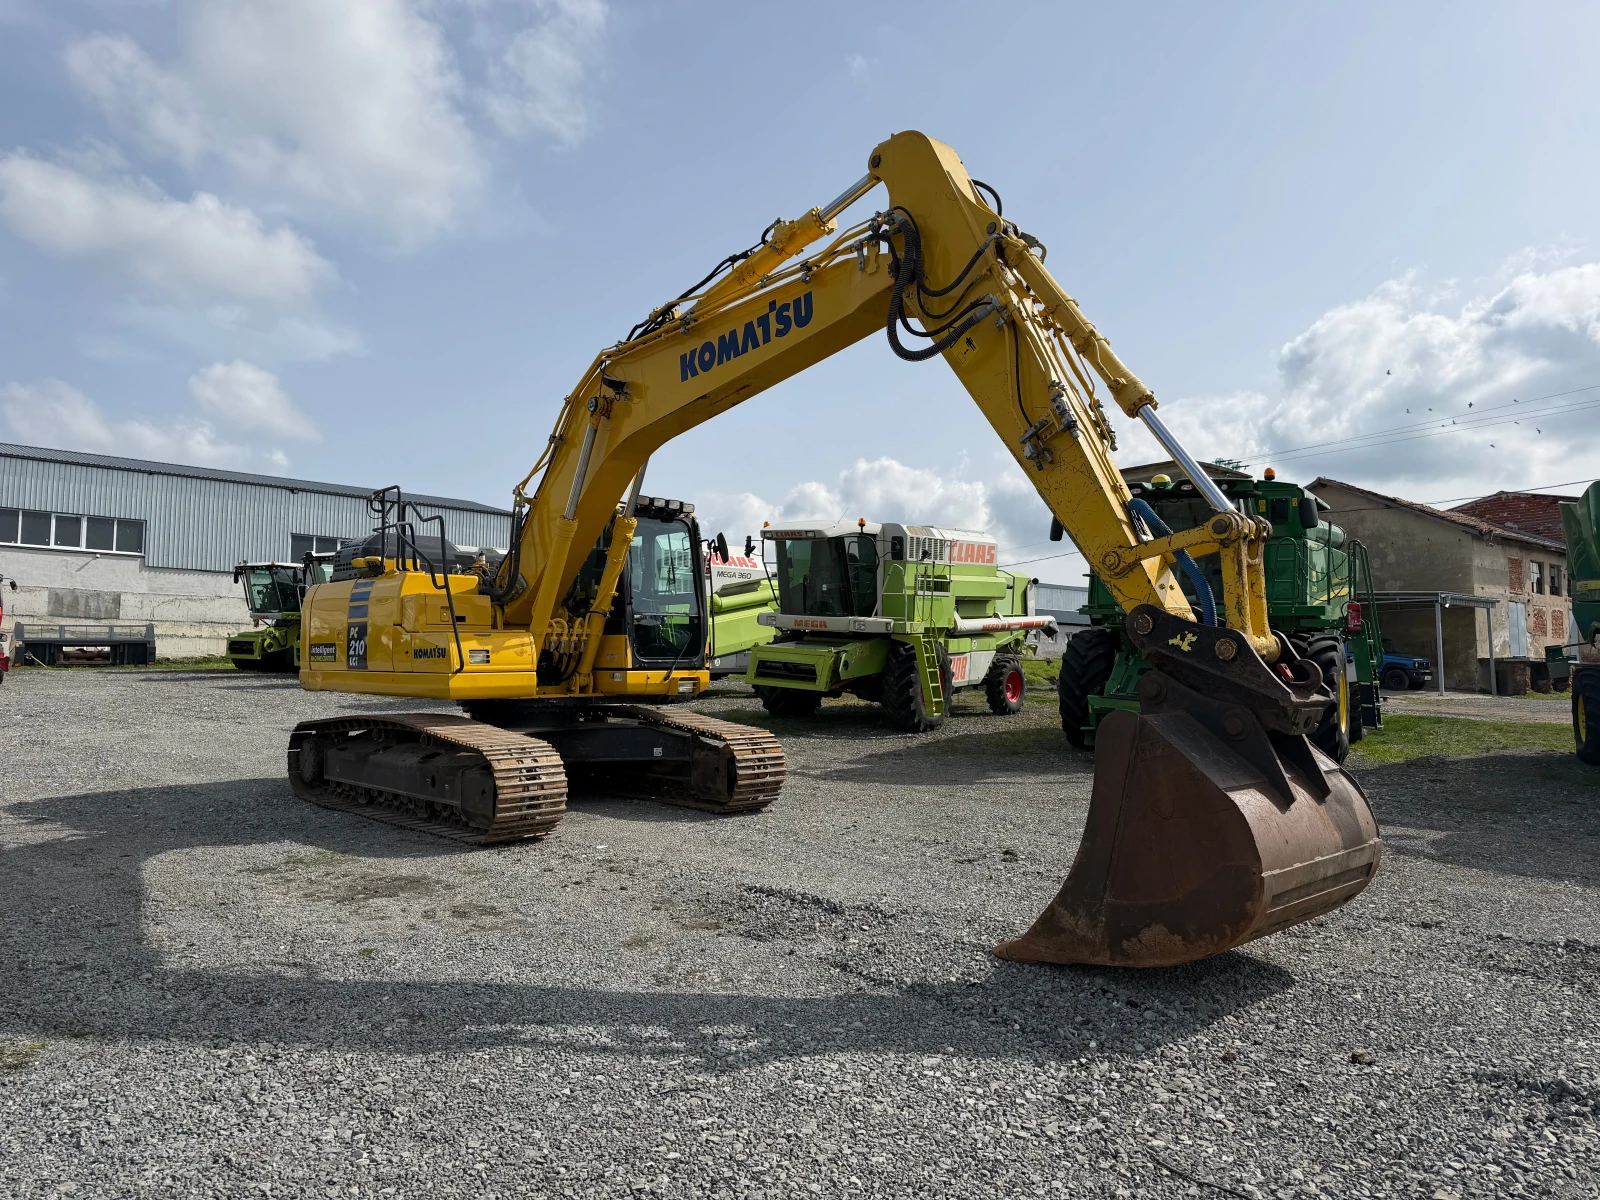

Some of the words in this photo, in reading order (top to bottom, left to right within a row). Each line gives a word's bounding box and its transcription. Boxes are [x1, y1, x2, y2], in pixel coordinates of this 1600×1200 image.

[680, 291, 813, 382] KOMATSU
[948, 541, 996, 564] CLAAS
[716, 570, 737, 578] MEGA
[737, 572, 752, 580] 360
[793, 619, 828, 629] MEGA
[350, 627, 359, 639] PC
[311, 645, 335, 656] intelligent
[349, 640, 365, 656] 210
[413, 644, 447, 660] KOMATSU
